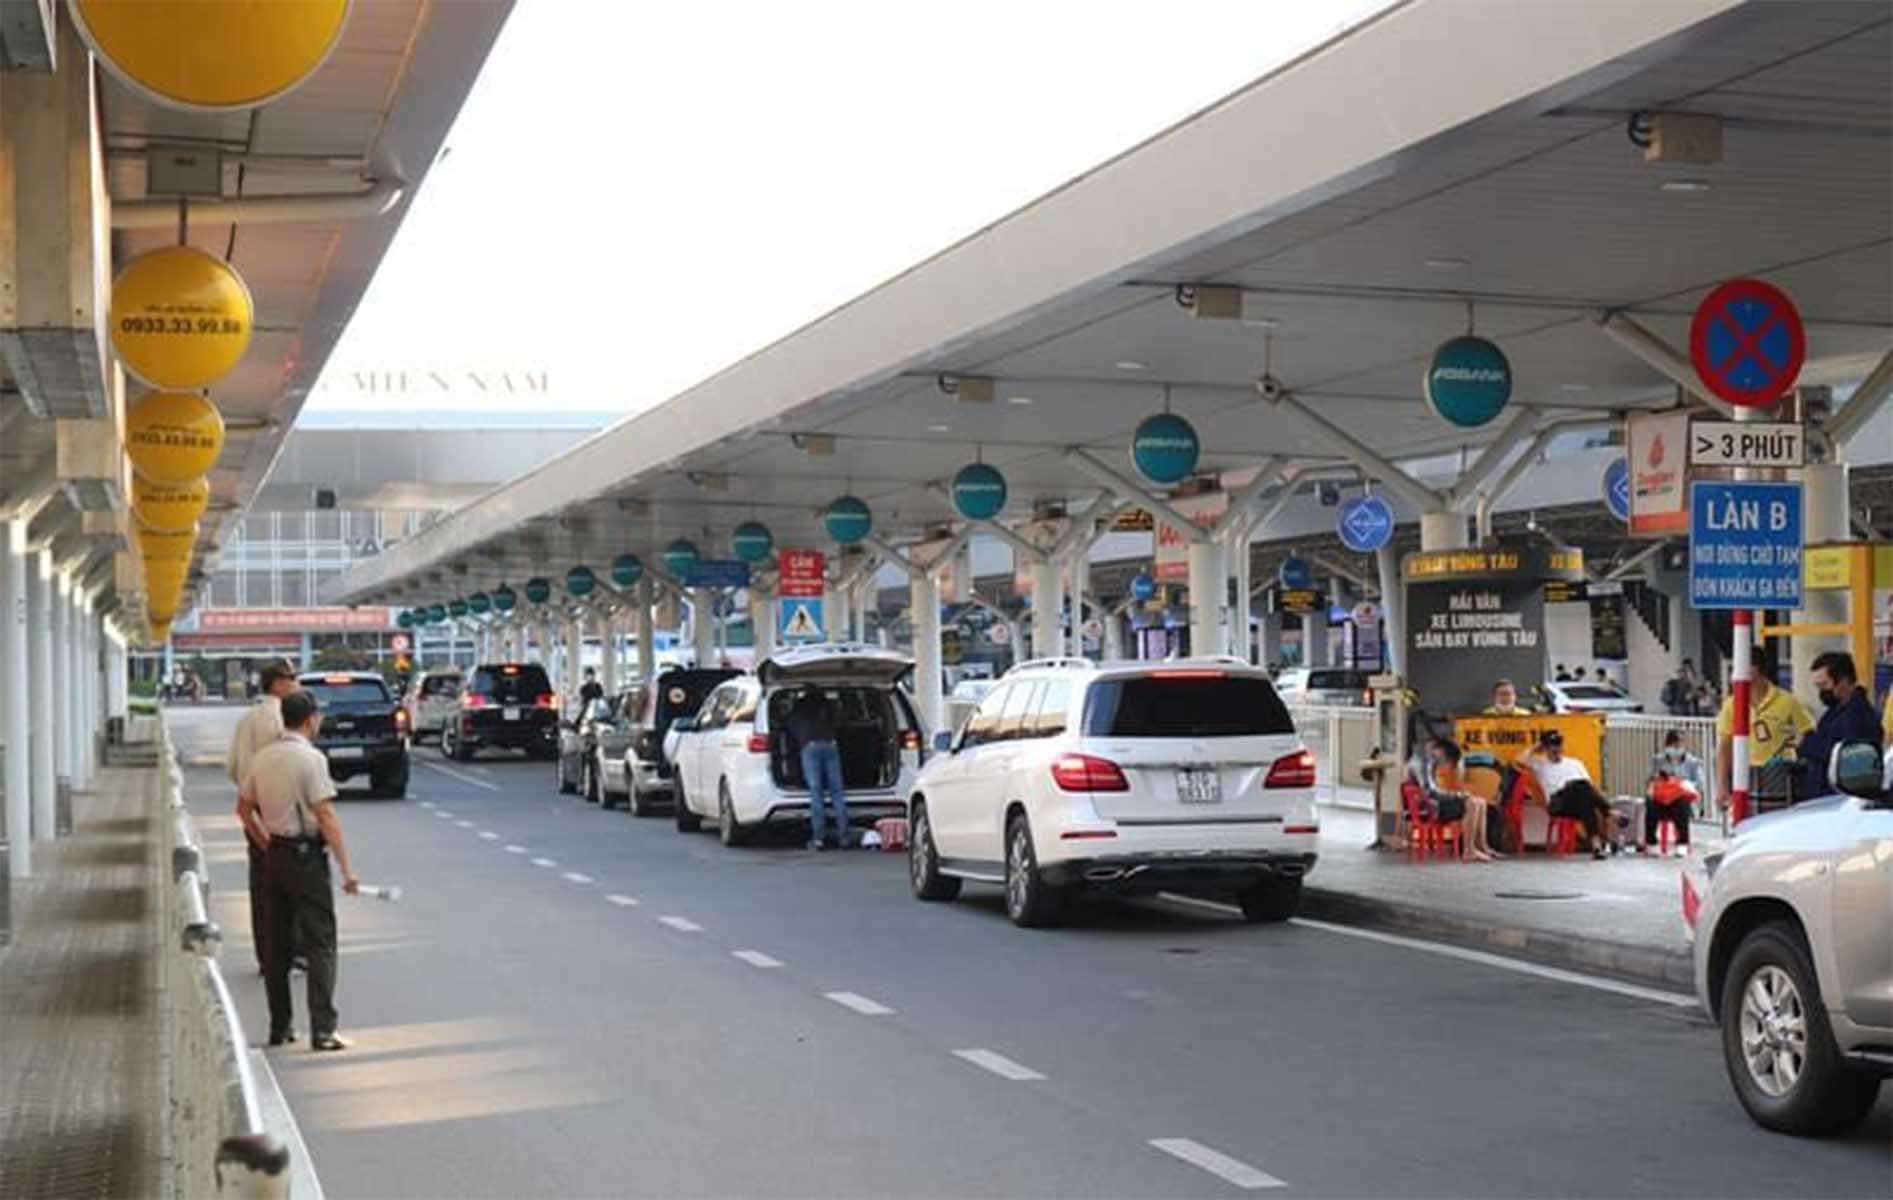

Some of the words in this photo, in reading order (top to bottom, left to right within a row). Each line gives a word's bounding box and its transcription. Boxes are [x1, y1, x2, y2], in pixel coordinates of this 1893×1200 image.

[1720, 433, 1734, 459] 3
[1741, 429, 1797, 460] PHÚT
[1706, 491, 1760, 532] LÀN
[1769, 501, 1788, 532] B
[1430, 613, 1447, 629] XE
[1415, 629, 1443, 649] SÂN
[1445, 631, 1469, 648] BAY
[1511, 628, 1537, 647] TÀU
[1464, 729, 1483, 745] XE
